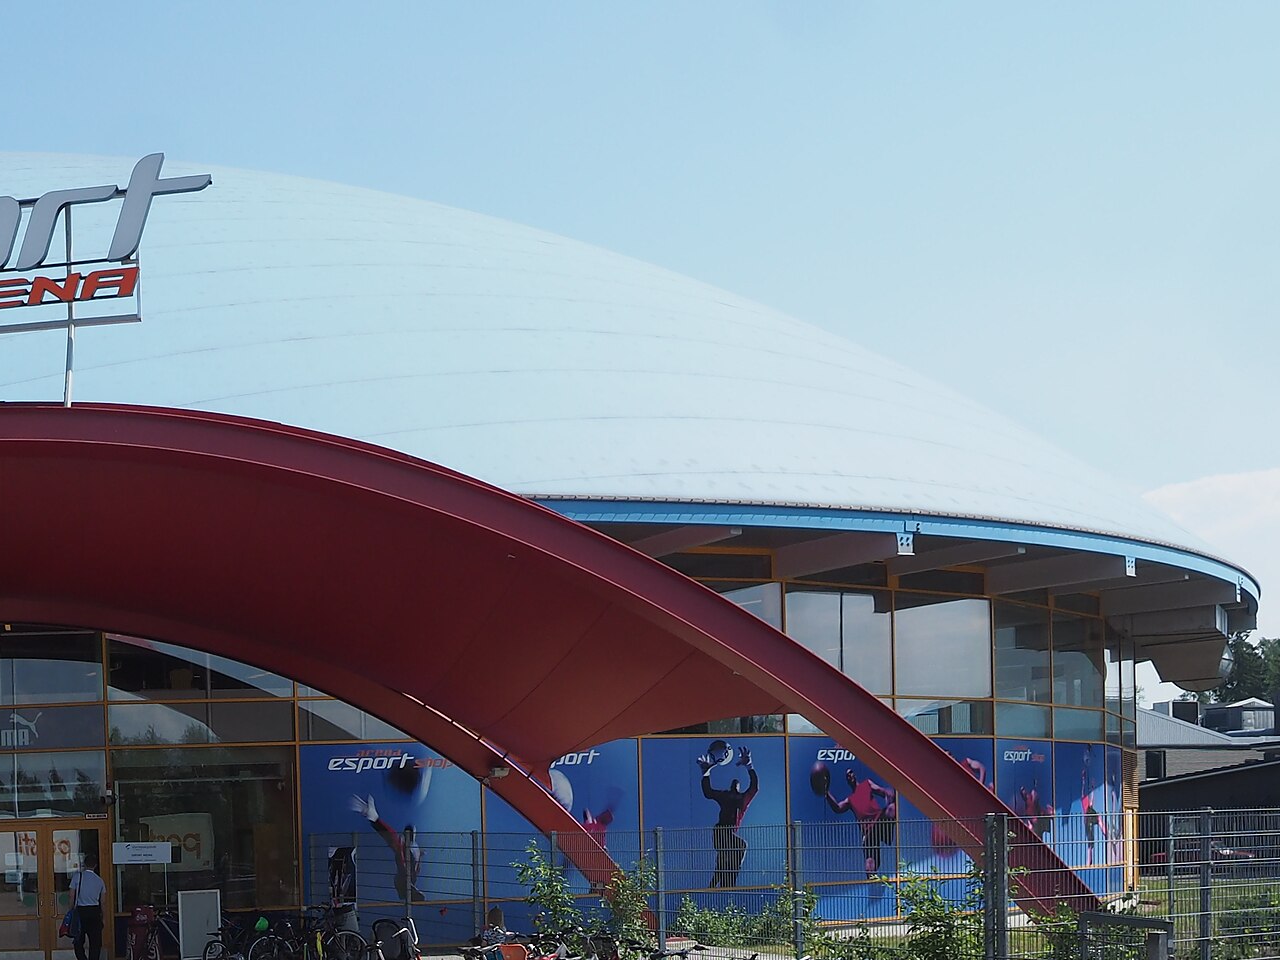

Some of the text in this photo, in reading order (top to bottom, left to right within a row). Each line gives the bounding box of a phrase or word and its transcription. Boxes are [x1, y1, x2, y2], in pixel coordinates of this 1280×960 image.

[328, 753, 415, 774] esport
[550, 749, 600, 769] port
[817, 749, 856, 764] espo
[1003, 749, 1032, 764] esport
